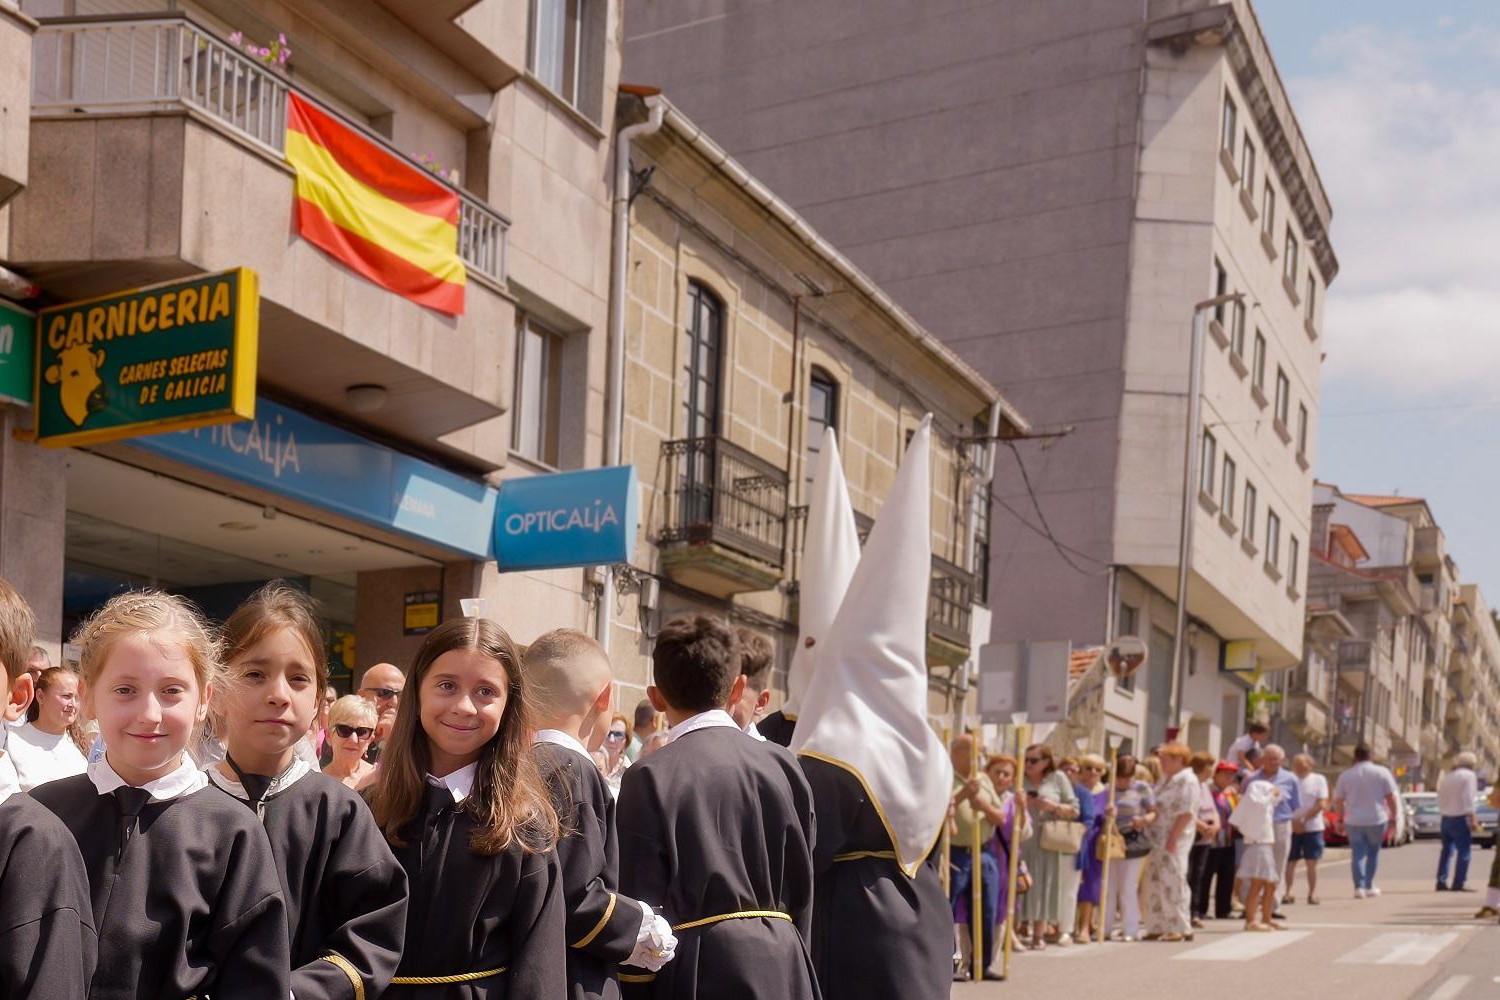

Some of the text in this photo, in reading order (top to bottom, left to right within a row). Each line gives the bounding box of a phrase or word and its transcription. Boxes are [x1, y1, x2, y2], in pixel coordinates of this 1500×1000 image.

[48, 282, 231, 350] CARNICERIA
[118, 348, 229, 385] CARNES SELECTAS
[139, 373, 227, 405] DE GALICIA
